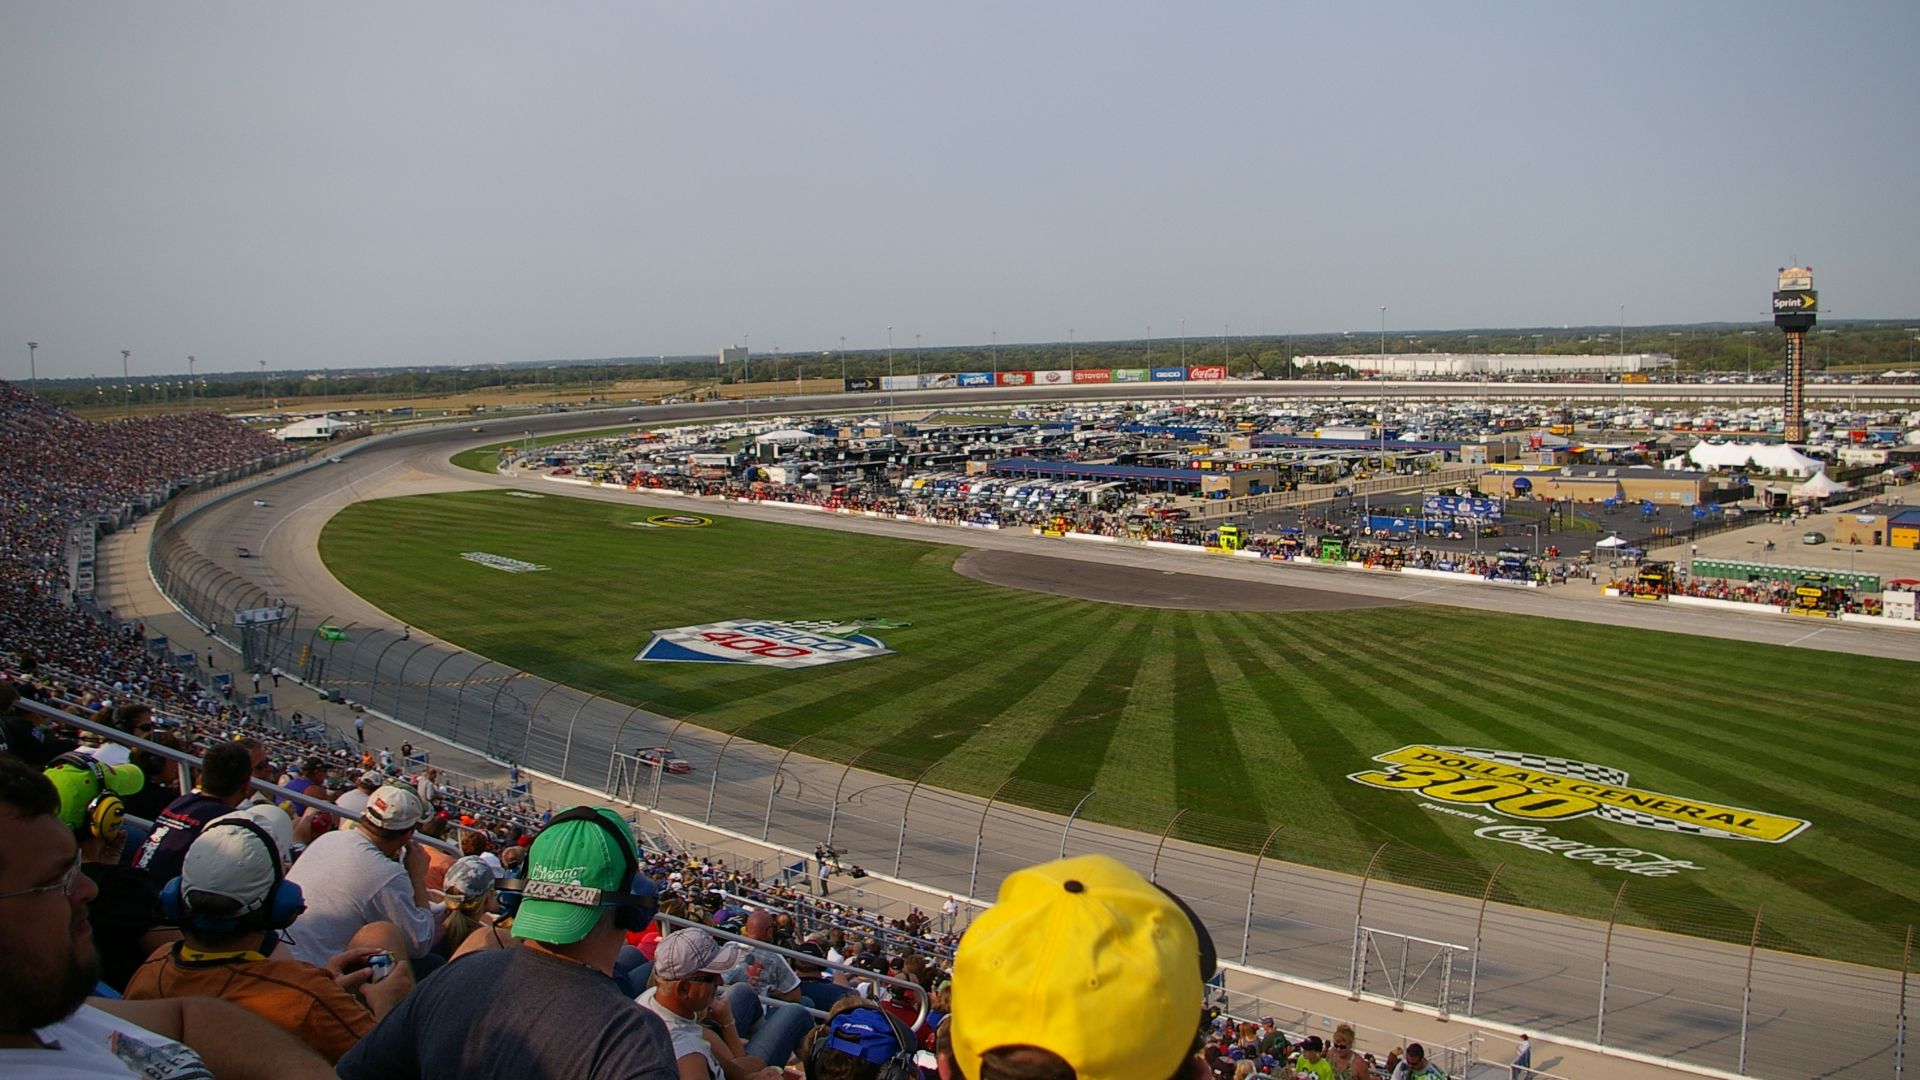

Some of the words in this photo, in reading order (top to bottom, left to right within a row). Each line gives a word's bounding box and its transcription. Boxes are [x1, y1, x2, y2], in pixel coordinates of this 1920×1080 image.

[1774, 299, 1802, 310] Sprint
[700, 632, 813, 658] 400
[735, 624, 856, 652] GEICO
[1349, 763, 1601, 820] 300
[1412, 752, 1561, 788] DOLLAR
[1568, 784, 1760, 831] GENERAL
